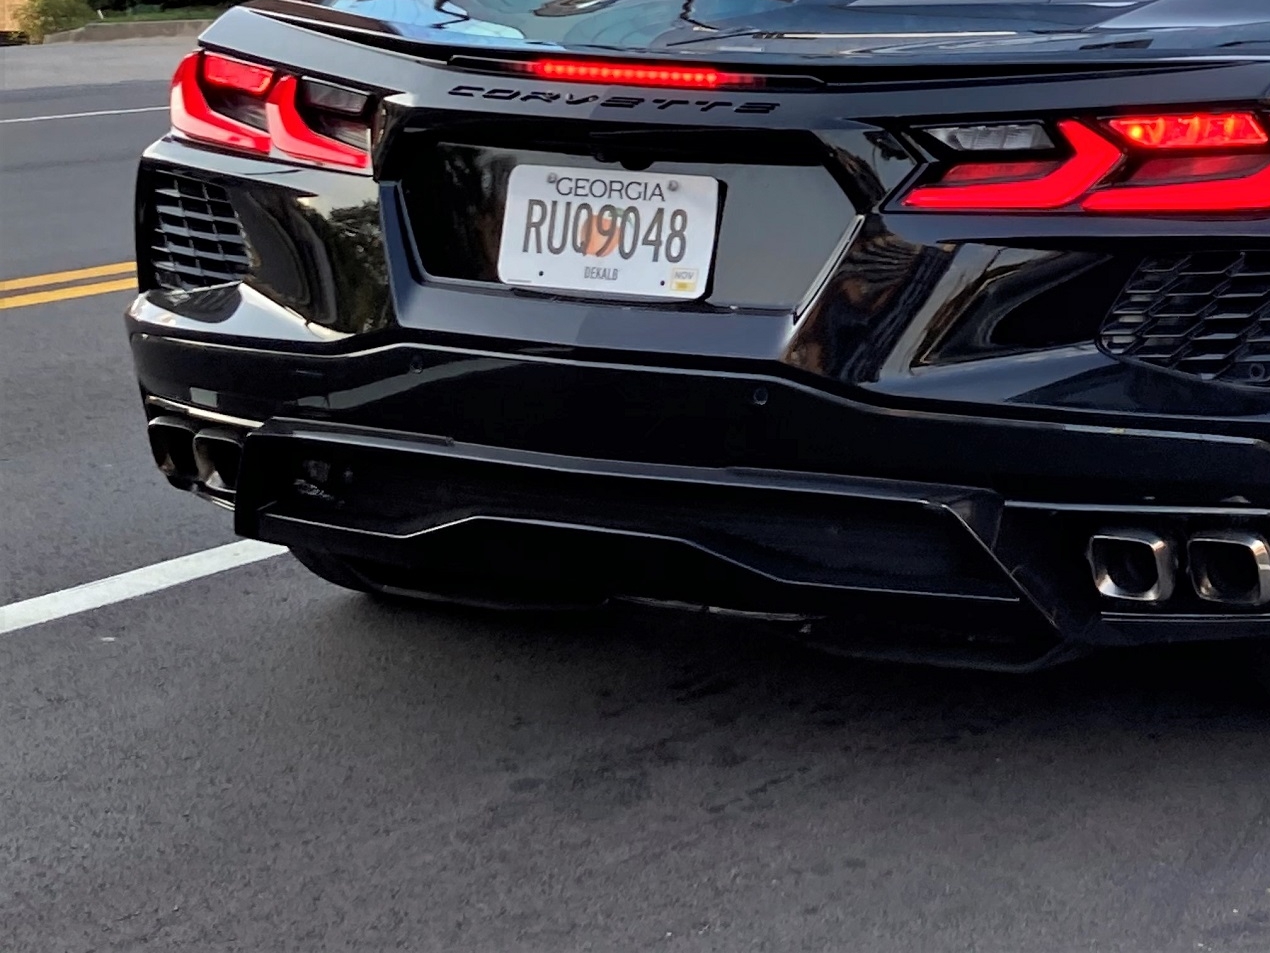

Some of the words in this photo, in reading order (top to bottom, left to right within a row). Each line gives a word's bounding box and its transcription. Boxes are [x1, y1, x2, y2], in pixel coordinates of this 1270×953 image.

[449, 85, 781, 114] CORVETTE
[555, 176, 666, 202] GEORGIA
[584, 266, 619, 281] DEKALB
[674, 270, 695, 280] NOV
